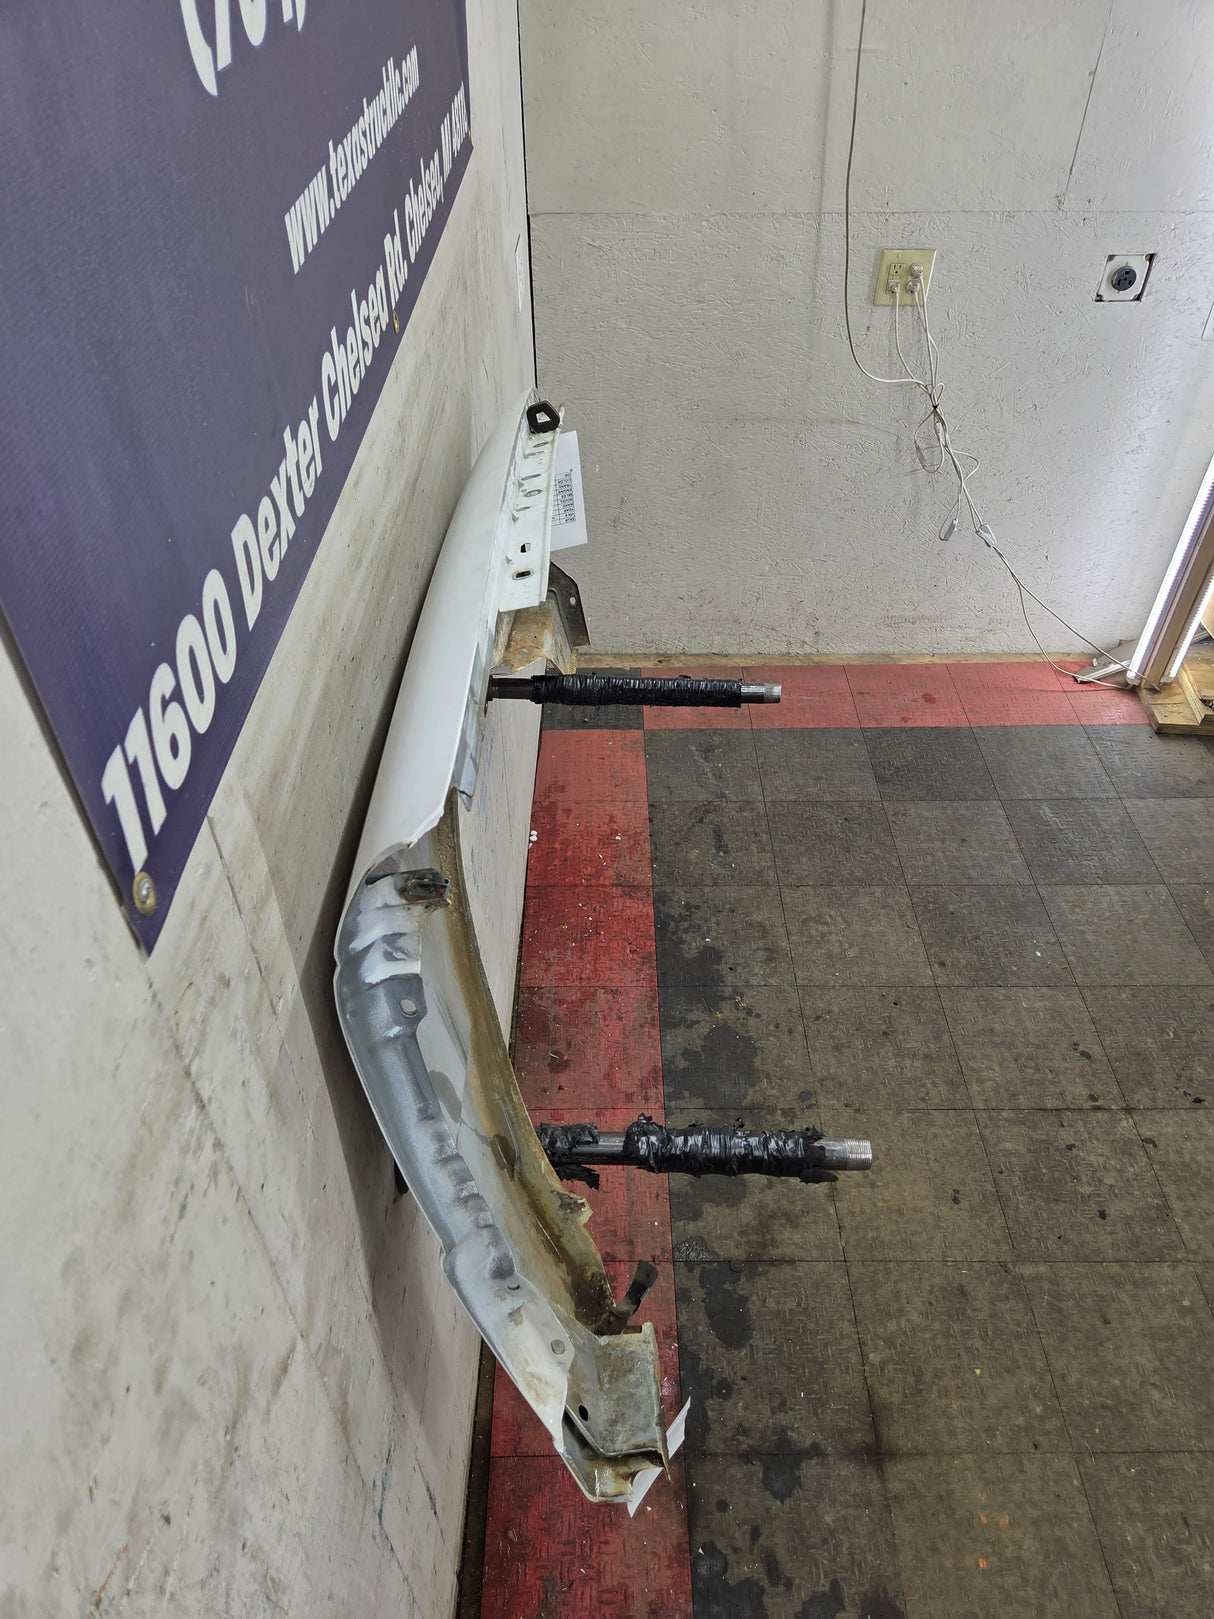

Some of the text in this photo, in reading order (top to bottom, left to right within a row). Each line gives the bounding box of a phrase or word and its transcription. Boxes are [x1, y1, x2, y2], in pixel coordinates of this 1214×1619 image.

[284, 45, 419, 274] www.texastruckllc.com
[101, 569, 236, 874] 11600
[231, 395, 323, 631] Dexter
[321, 288, 388, 441] Chelsea
[383, 208, 408, 309] Rd.
[404, 148, 444, 263] Chelsea,
[441, 112, 452, 184] MI
